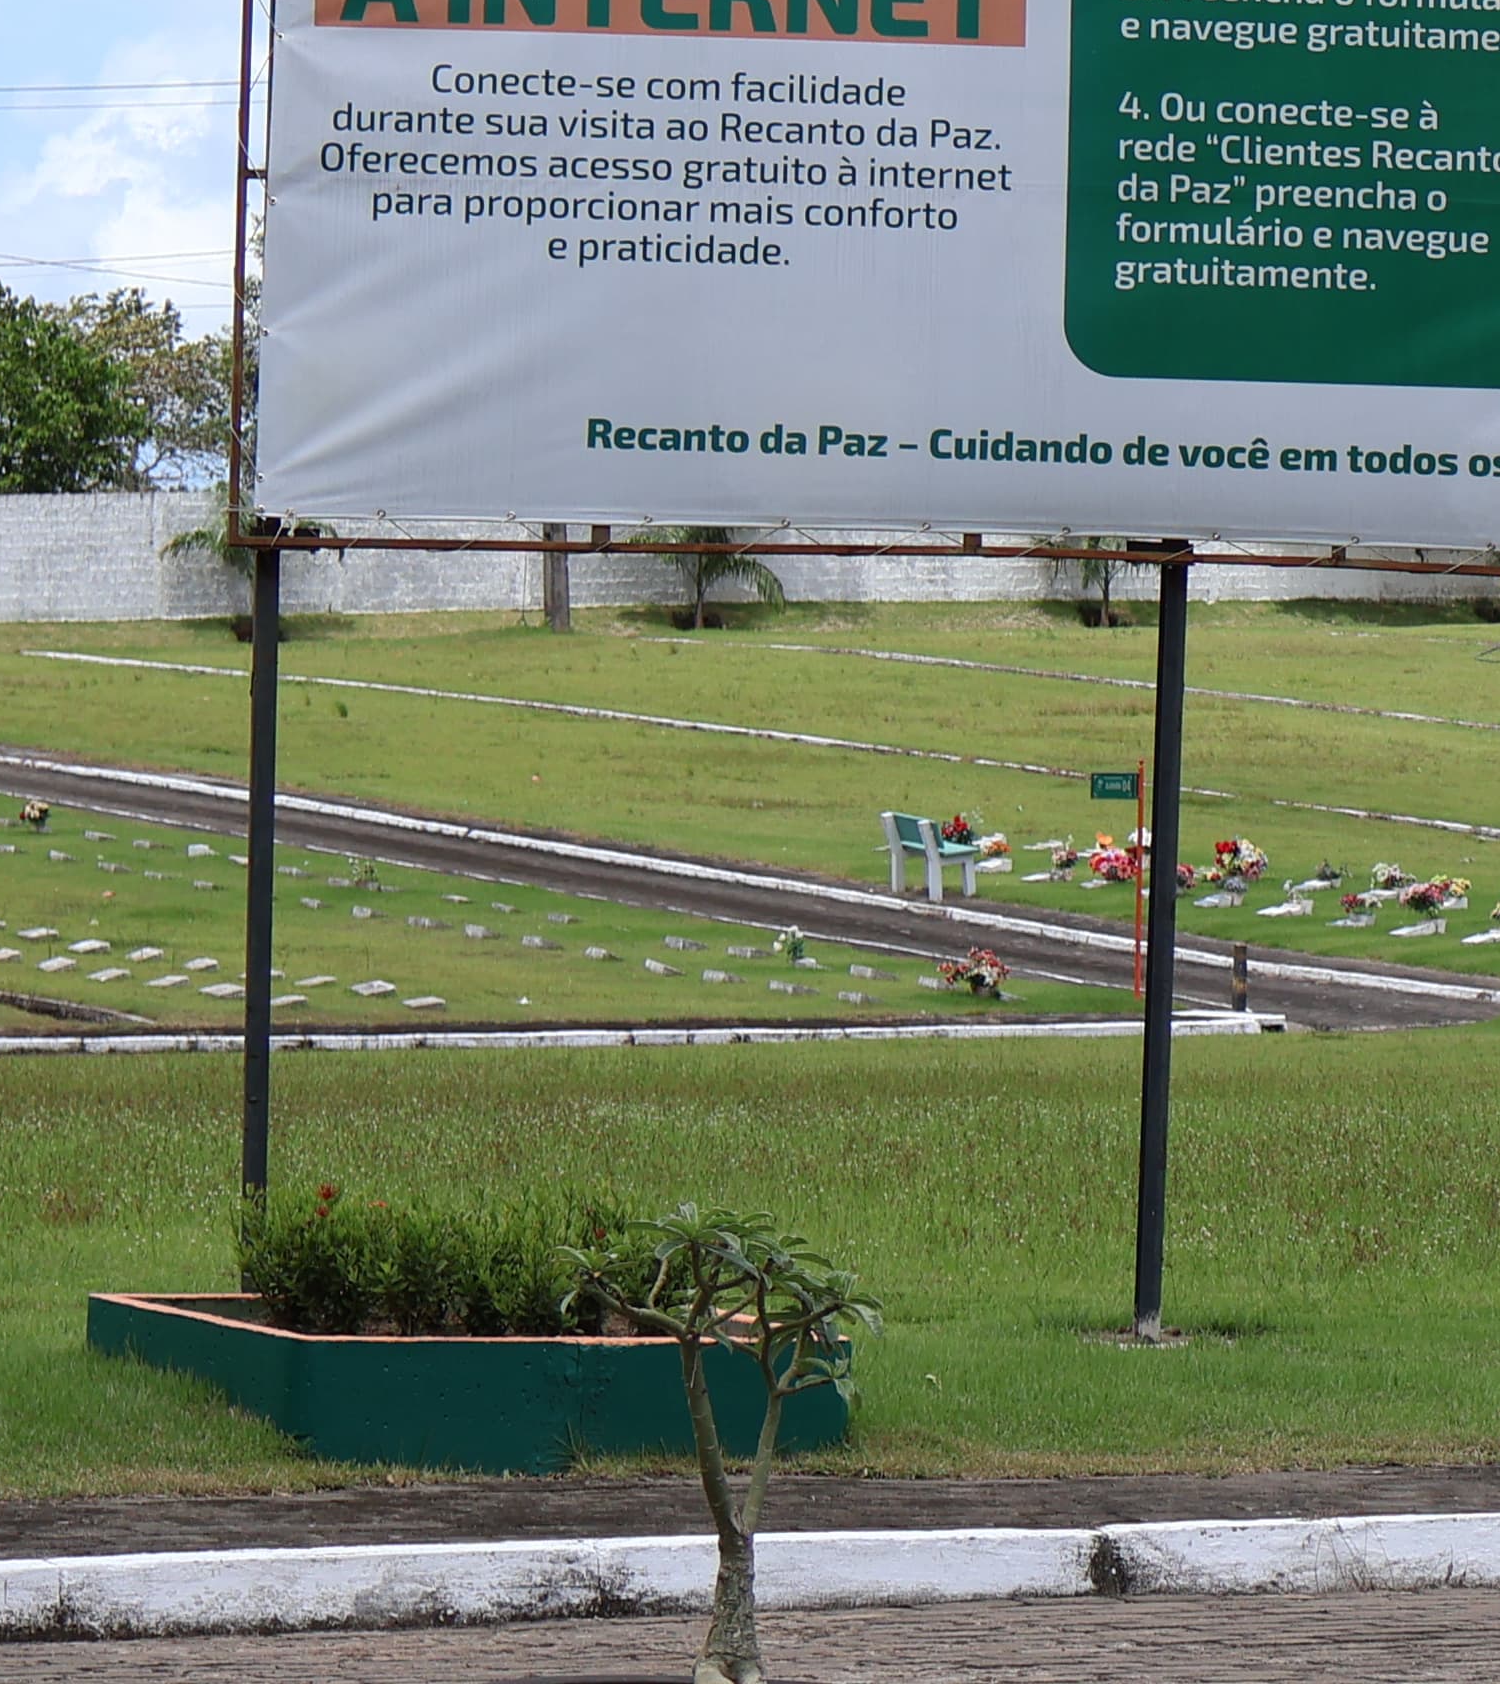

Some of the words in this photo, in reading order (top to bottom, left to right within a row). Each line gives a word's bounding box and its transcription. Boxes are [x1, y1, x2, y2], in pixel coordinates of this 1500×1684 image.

[1120, 17, 1140, 39] e
[1150, 18, 1298, 50] navegue
[432, 64, 636, 99] Conecte-se
[647, 78, 720, 101] com
[730, 72, 906, 107] facilidade
[333, 102, 475, 135] durante
[485, 114, 548, 137] sua
[558, 108, 654, 140] visita
[666, 119, 709, 142] ao
[721, 112, 865, 146] Recanto
[876, 117, 918, 148] da
[930, 119, 1001, 150] Paz.
[1118, 91, 1150, 120] 4.
[1160, 92, 1206, 122] Ou
[1216, 100, 1410, 129] conecte-se
[1419, 100, 1438, 130] à
[320, 142, 537, 177] Oferecemos
[548, 156, 672, 181] acesso
[683, 155, 827, 190] gratuito
[838, 155, 857, 186] à
[869, 157, 1013, 191] internet
[1119, 133, 1196, 162] rede
[372, 192, 452, 221] para
[464, 191, 700, 226] proporcionar
[710, 195, 793, 225] mais
[804, 197, 958, 230] conforto
[1118, 172, 1159, 202] da
[1255, 180, 1416, 213] preencha
[1427, 190, 1447, 212] o
[548, 238, 567, 260] e
[579, 233, 789, 268] praticidade.
[1116, 212, 1303, 247] formulário
[1313, 227, 1332, 248] e
[1343, 228, 1489, 259] navegue
[1114, 256, 1376, 290] gratuitamente.
[587, 418, 750, 454] Recanto
[759, 423, 807, 455] da
[818, 425, 888, 457] Paz
[929, 428, 1113, 465] Cuidando
[1122, 435, 1170, 467] de
[1178, 437, 1270, 470] você
[1279, 448, 1338, 472] em
[1346, 444, 1458, 476] todos
